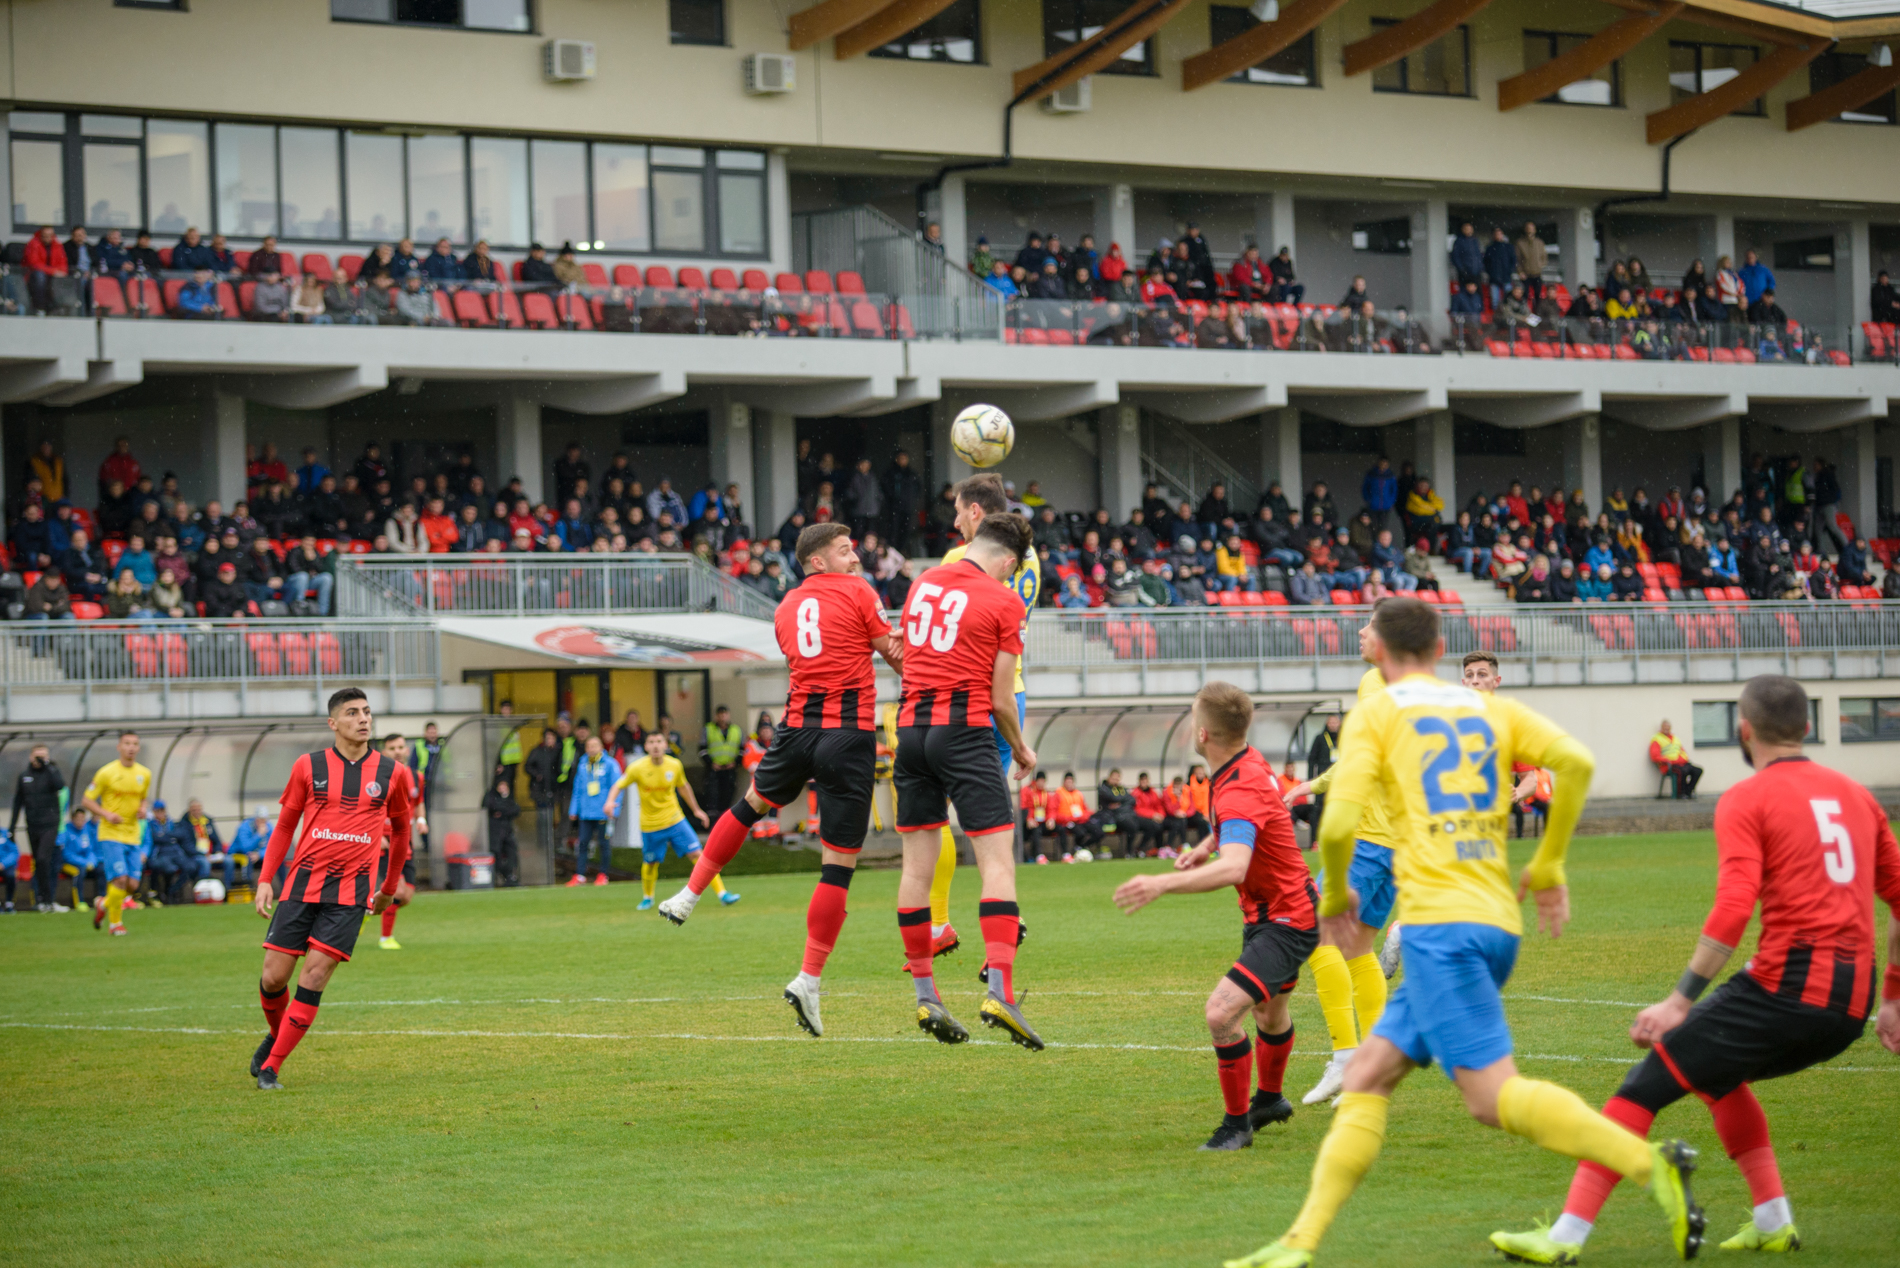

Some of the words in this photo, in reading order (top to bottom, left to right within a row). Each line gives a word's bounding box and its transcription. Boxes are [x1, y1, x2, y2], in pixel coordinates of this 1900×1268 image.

[797, 598, 823, 658] 8
[907, 582, 968, 652] 53
[1413, 716, 1498, 815] 23
[311, 827, 372, 844] Csíkszereda
[1809, 799, 1855, 884] 5
